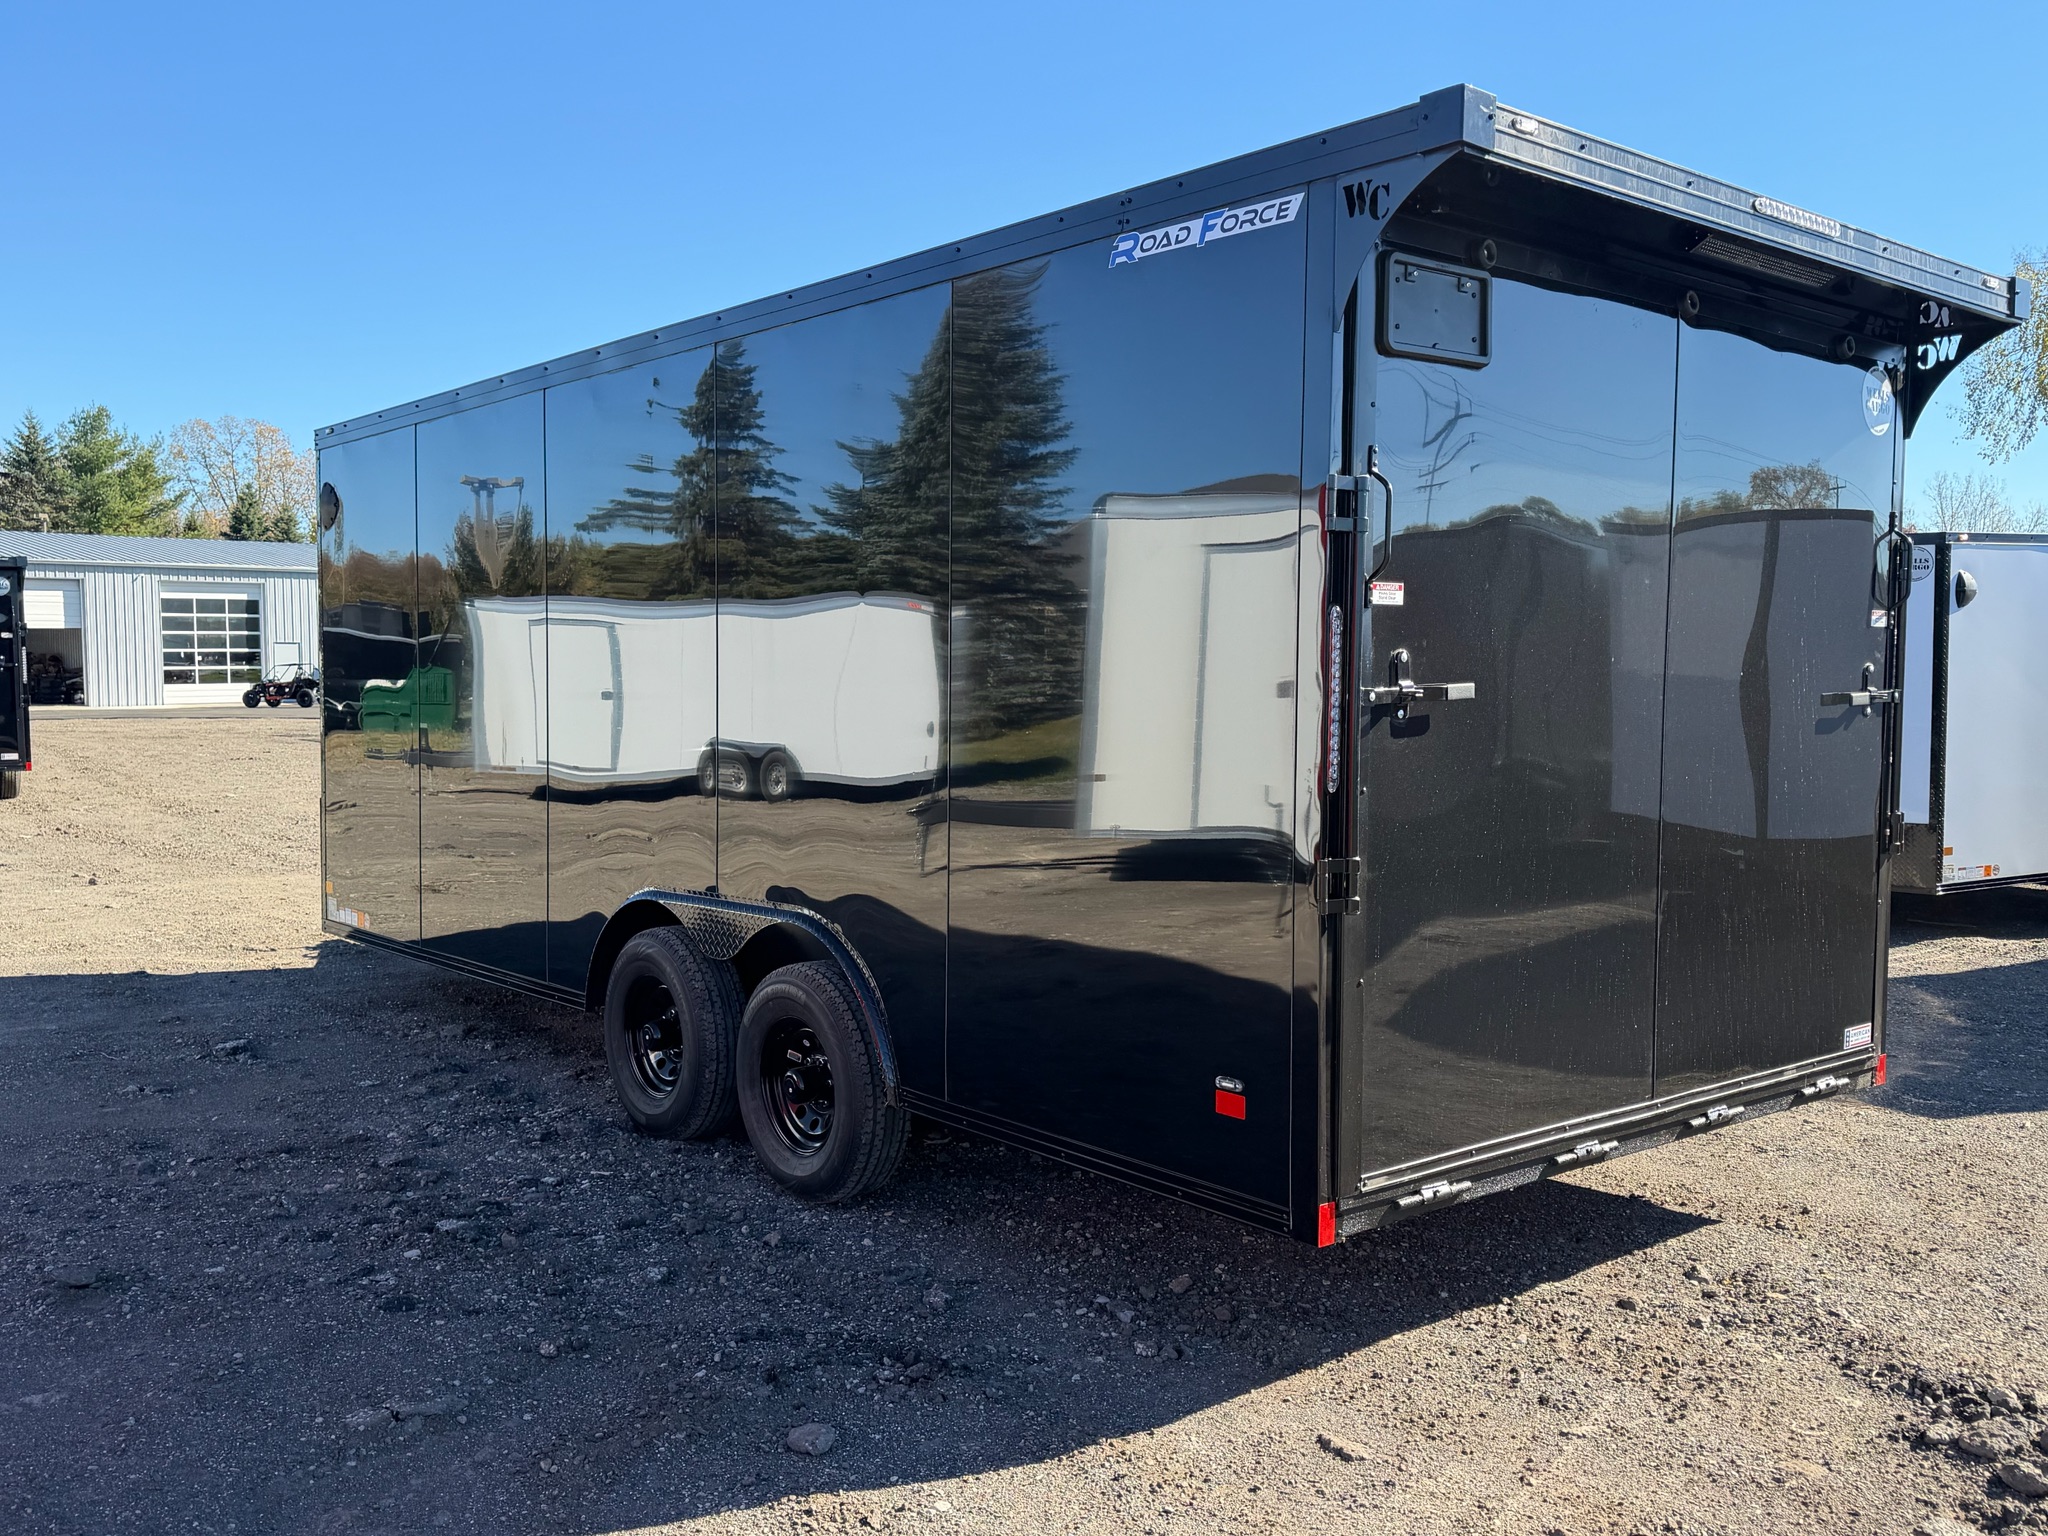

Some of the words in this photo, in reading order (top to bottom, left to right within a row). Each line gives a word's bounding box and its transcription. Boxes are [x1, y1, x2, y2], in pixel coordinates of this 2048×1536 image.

[1343, 178, 1390, 220] WC
[1109, 226, 1191, 267] ROAD
[1197, 199, 1293, 247] FORCE
